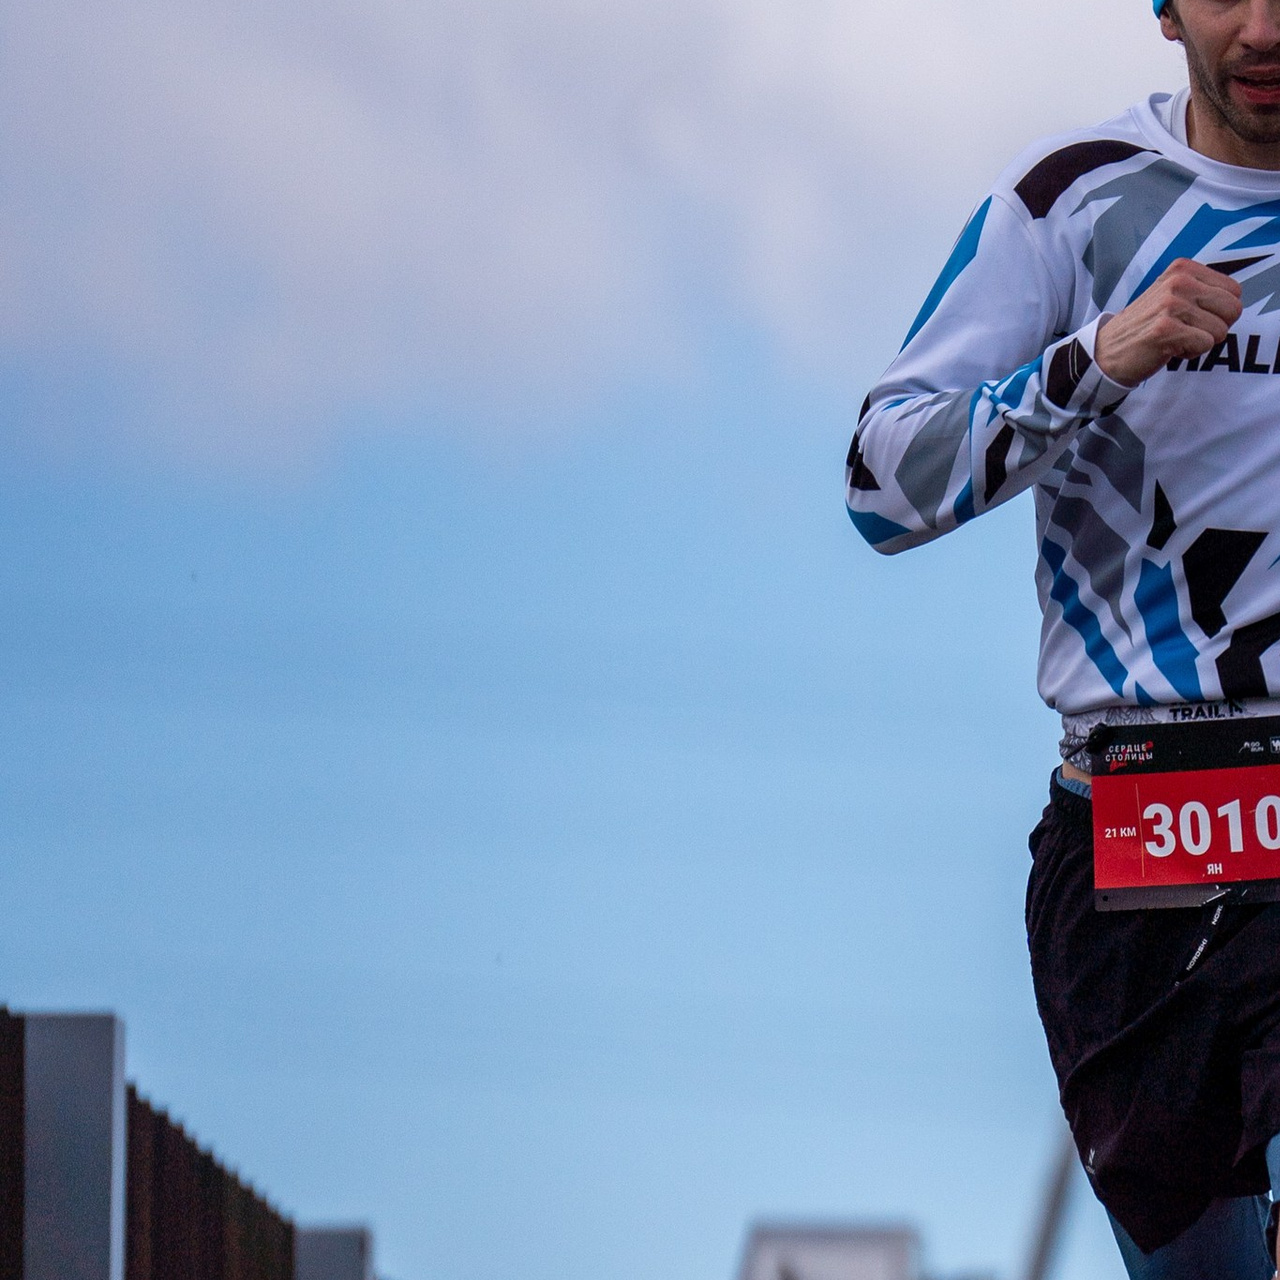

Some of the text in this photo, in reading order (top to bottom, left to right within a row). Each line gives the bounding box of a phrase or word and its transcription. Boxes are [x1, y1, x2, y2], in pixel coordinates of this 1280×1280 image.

[1108, 743, 1147, 753] СЕРДЦЕ
[1105, 752, 1153, 762] СТОЛИЦЫ
[1104, 828, 1117, 839] 21
[1207, 863, 1223, 875] ЯН
